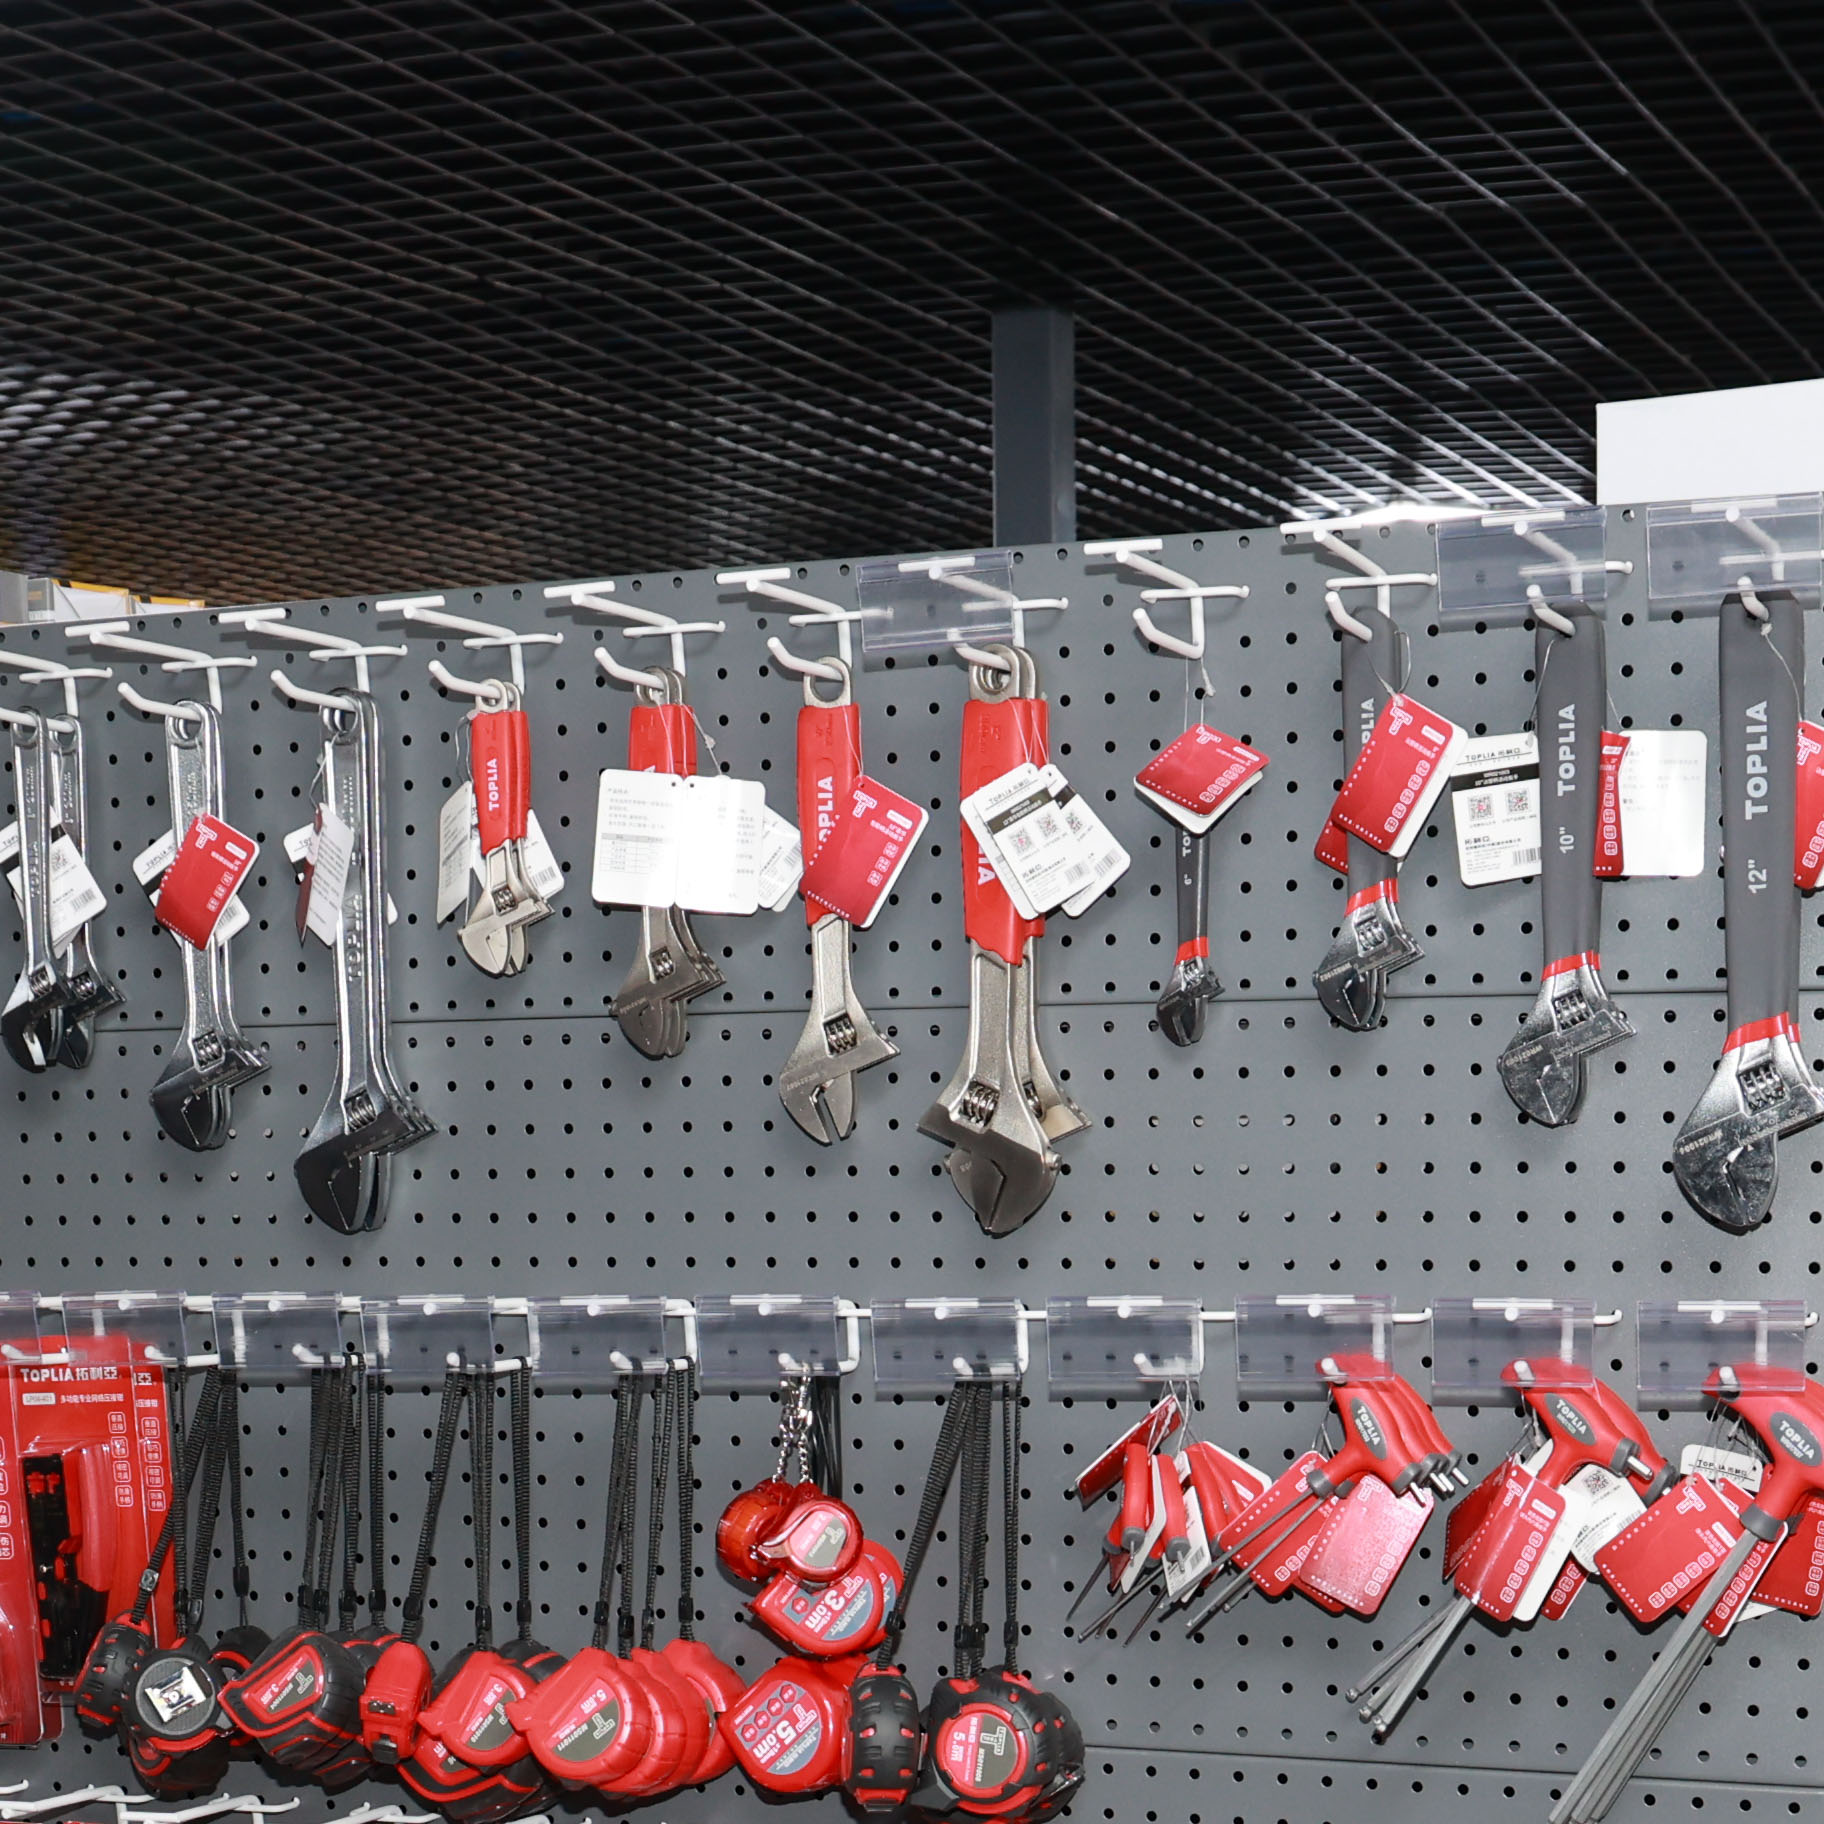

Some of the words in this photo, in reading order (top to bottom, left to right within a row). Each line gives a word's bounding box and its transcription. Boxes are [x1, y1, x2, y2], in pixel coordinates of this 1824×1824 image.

[1558, 702, 1577, 796] TOPLIA
[1745, 701, 1768, 821] TOPLIA
[487, 757, 500, 815] TOPLIA
[1559, 826, 1575, 854] 10"
[1748, 858, 1767, 894] 12"
[21, 1368, 74, 1383] TOPLIA
[76, 1366, 118, 1380] 拓利亞
[1356, 1405, 1382, 1446] TOPLIA
[1555, 1400, 1587, 1435] TOPLIA
[1779, 1418, 1814, 1459] TOPLIA
